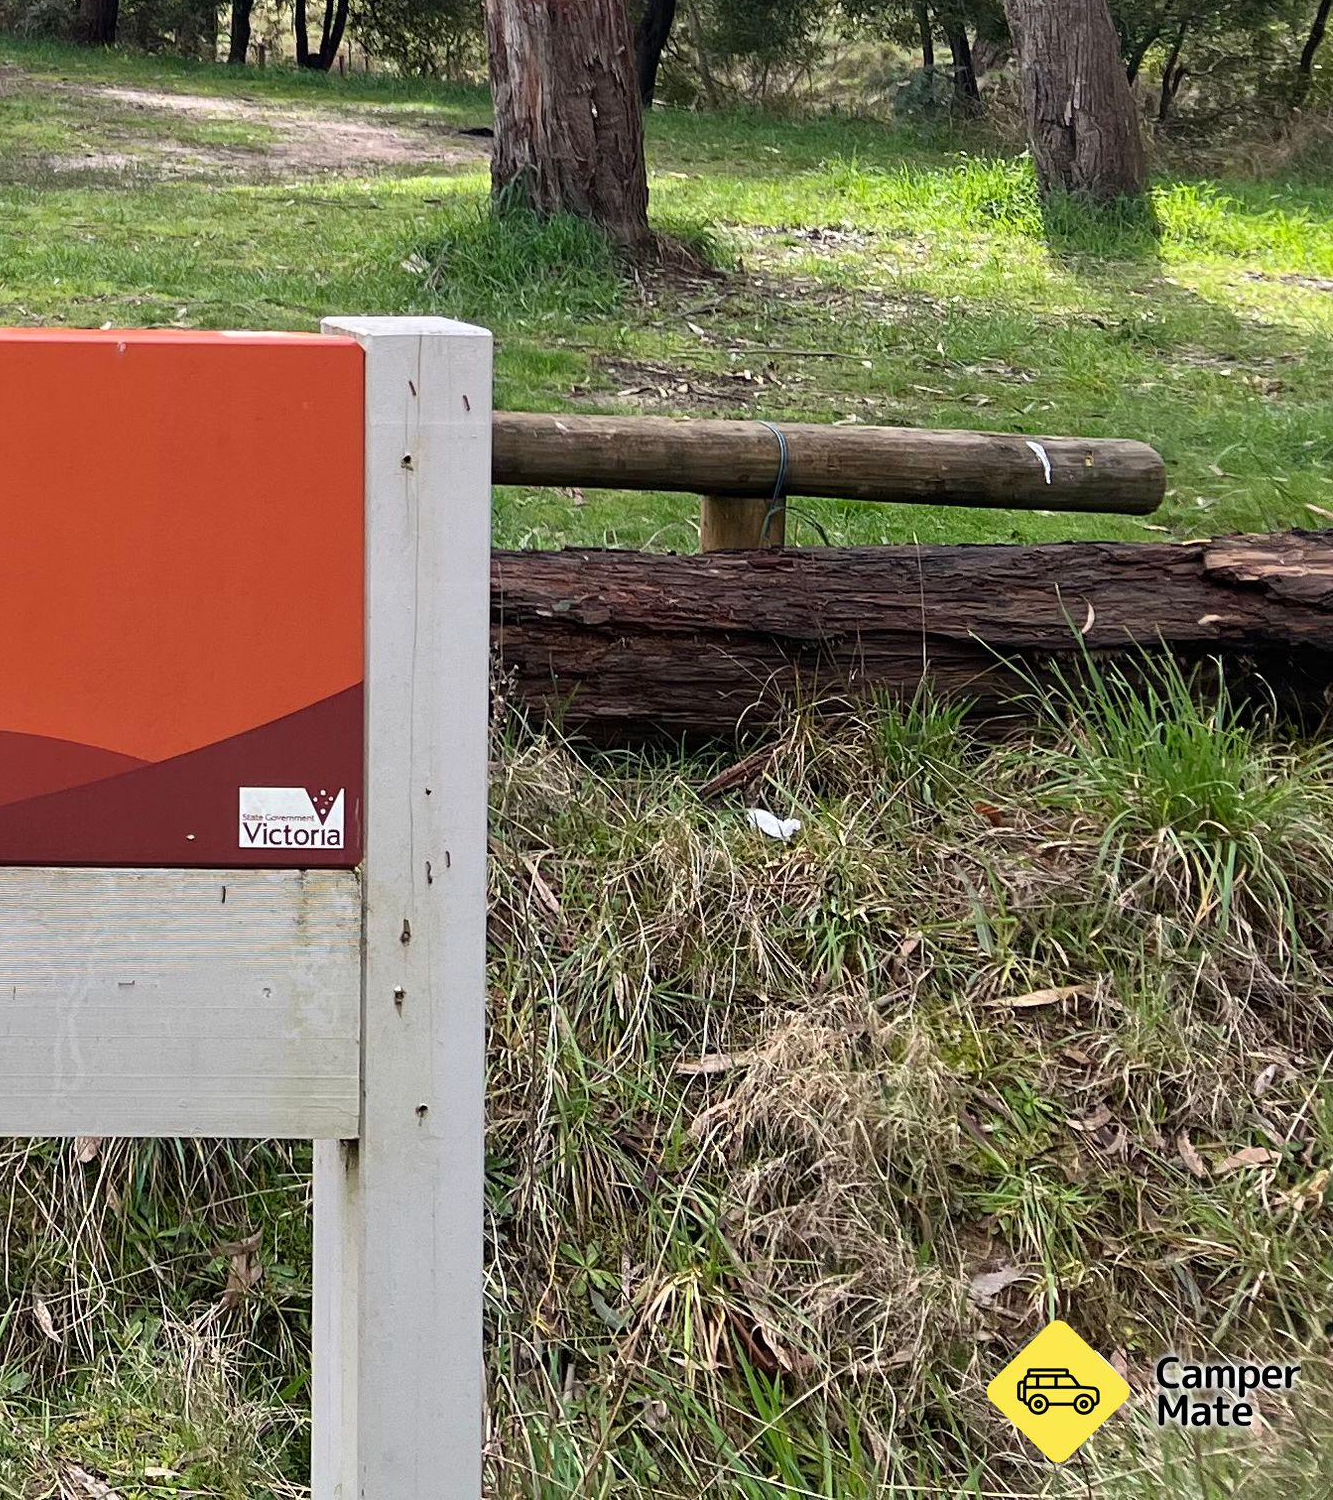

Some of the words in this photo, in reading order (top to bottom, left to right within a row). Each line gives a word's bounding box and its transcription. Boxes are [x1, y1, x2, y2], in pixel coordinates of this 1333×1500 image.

[242, 813, 264, 821] State
[265, 813, 315, 822] Government
[242, 822, 341, 846] Victoria
